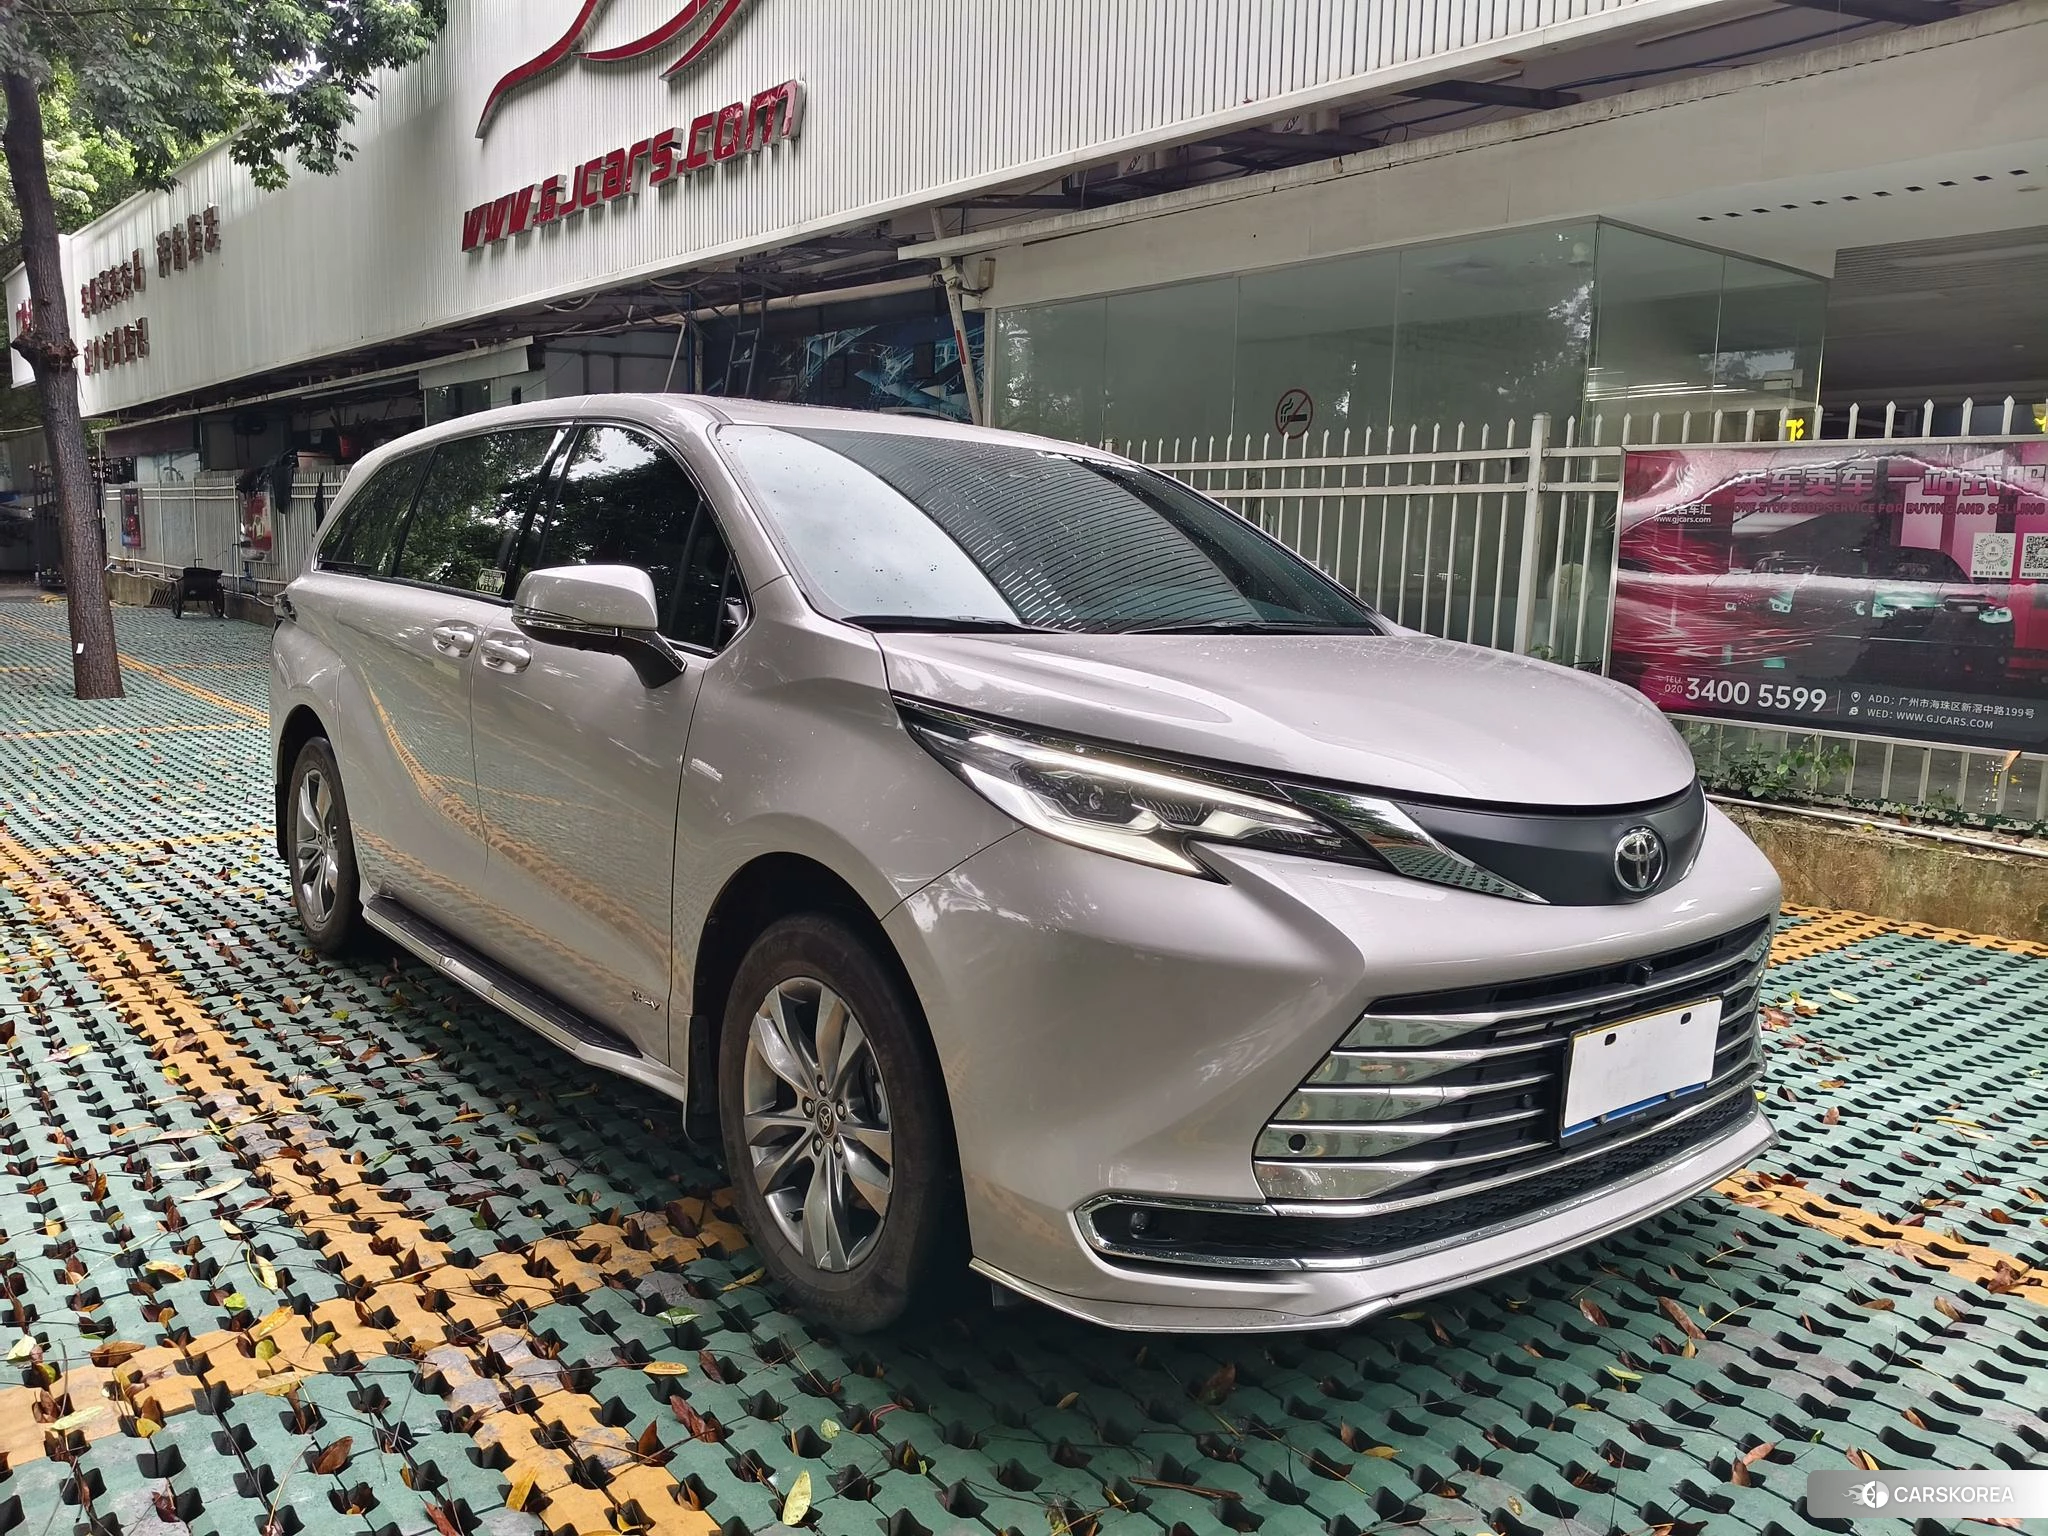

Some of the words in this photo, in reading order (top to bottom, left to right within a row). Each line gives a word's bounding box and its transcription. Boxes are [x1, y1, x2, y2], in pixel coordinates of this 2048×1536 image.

[1759, 502, 1789, 513] STOP
[1824, 502, 1876, 513] SERVICE
[1878, 503, 1903, 513] FOR
[1906, 503, 1954, 514] BUYING
[1957, 503, 1985, 514] AND
[1987, 503, 2045, 515] SELLING
[1654, 515, 1711, 525] www.gjcars.com
[1665, 684, 1683, 694] 020
[1685, 677, 1750, 705] 3400
[1757, 683, 1827, 712] 5599
[1896, 711, 1994, 729] WWW.GJCARS.COM
